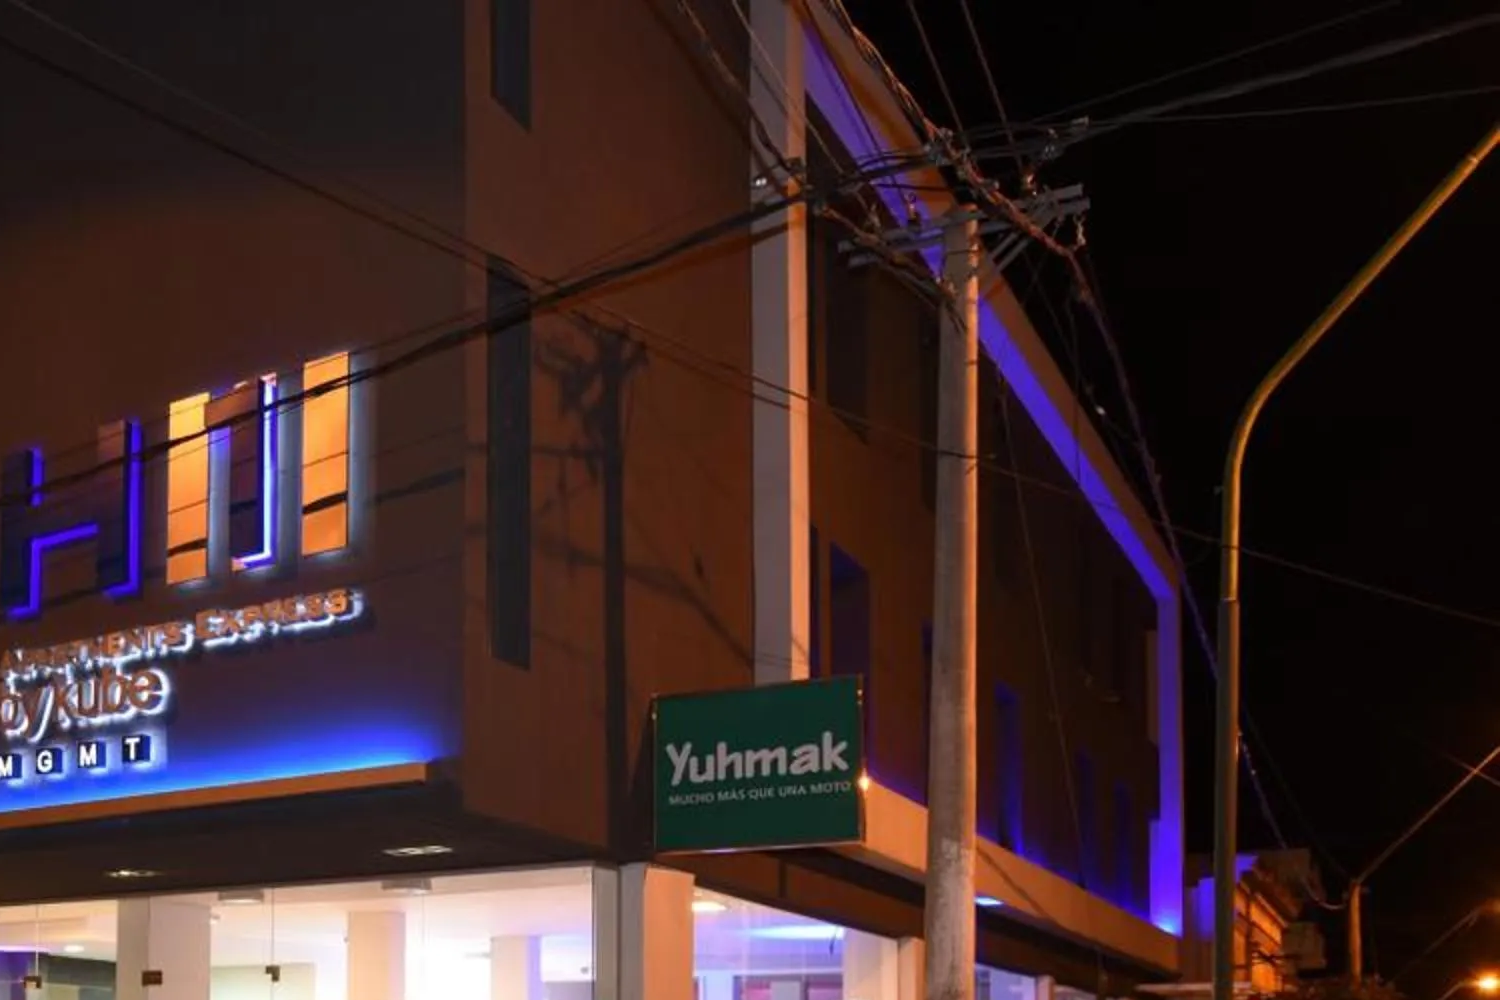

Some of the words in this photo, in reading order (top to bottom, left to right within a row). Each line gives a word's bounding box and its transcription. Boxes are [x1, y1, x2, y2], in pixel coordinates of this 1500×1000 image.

[665, 730, 850, 787] Yuhmak
[668, 792, 715, 806] MUCHO
[749, 786, 774, 801] QUE
[778, 784, 807, 798] UNA
[810, 780, 851, 794] MOTO
